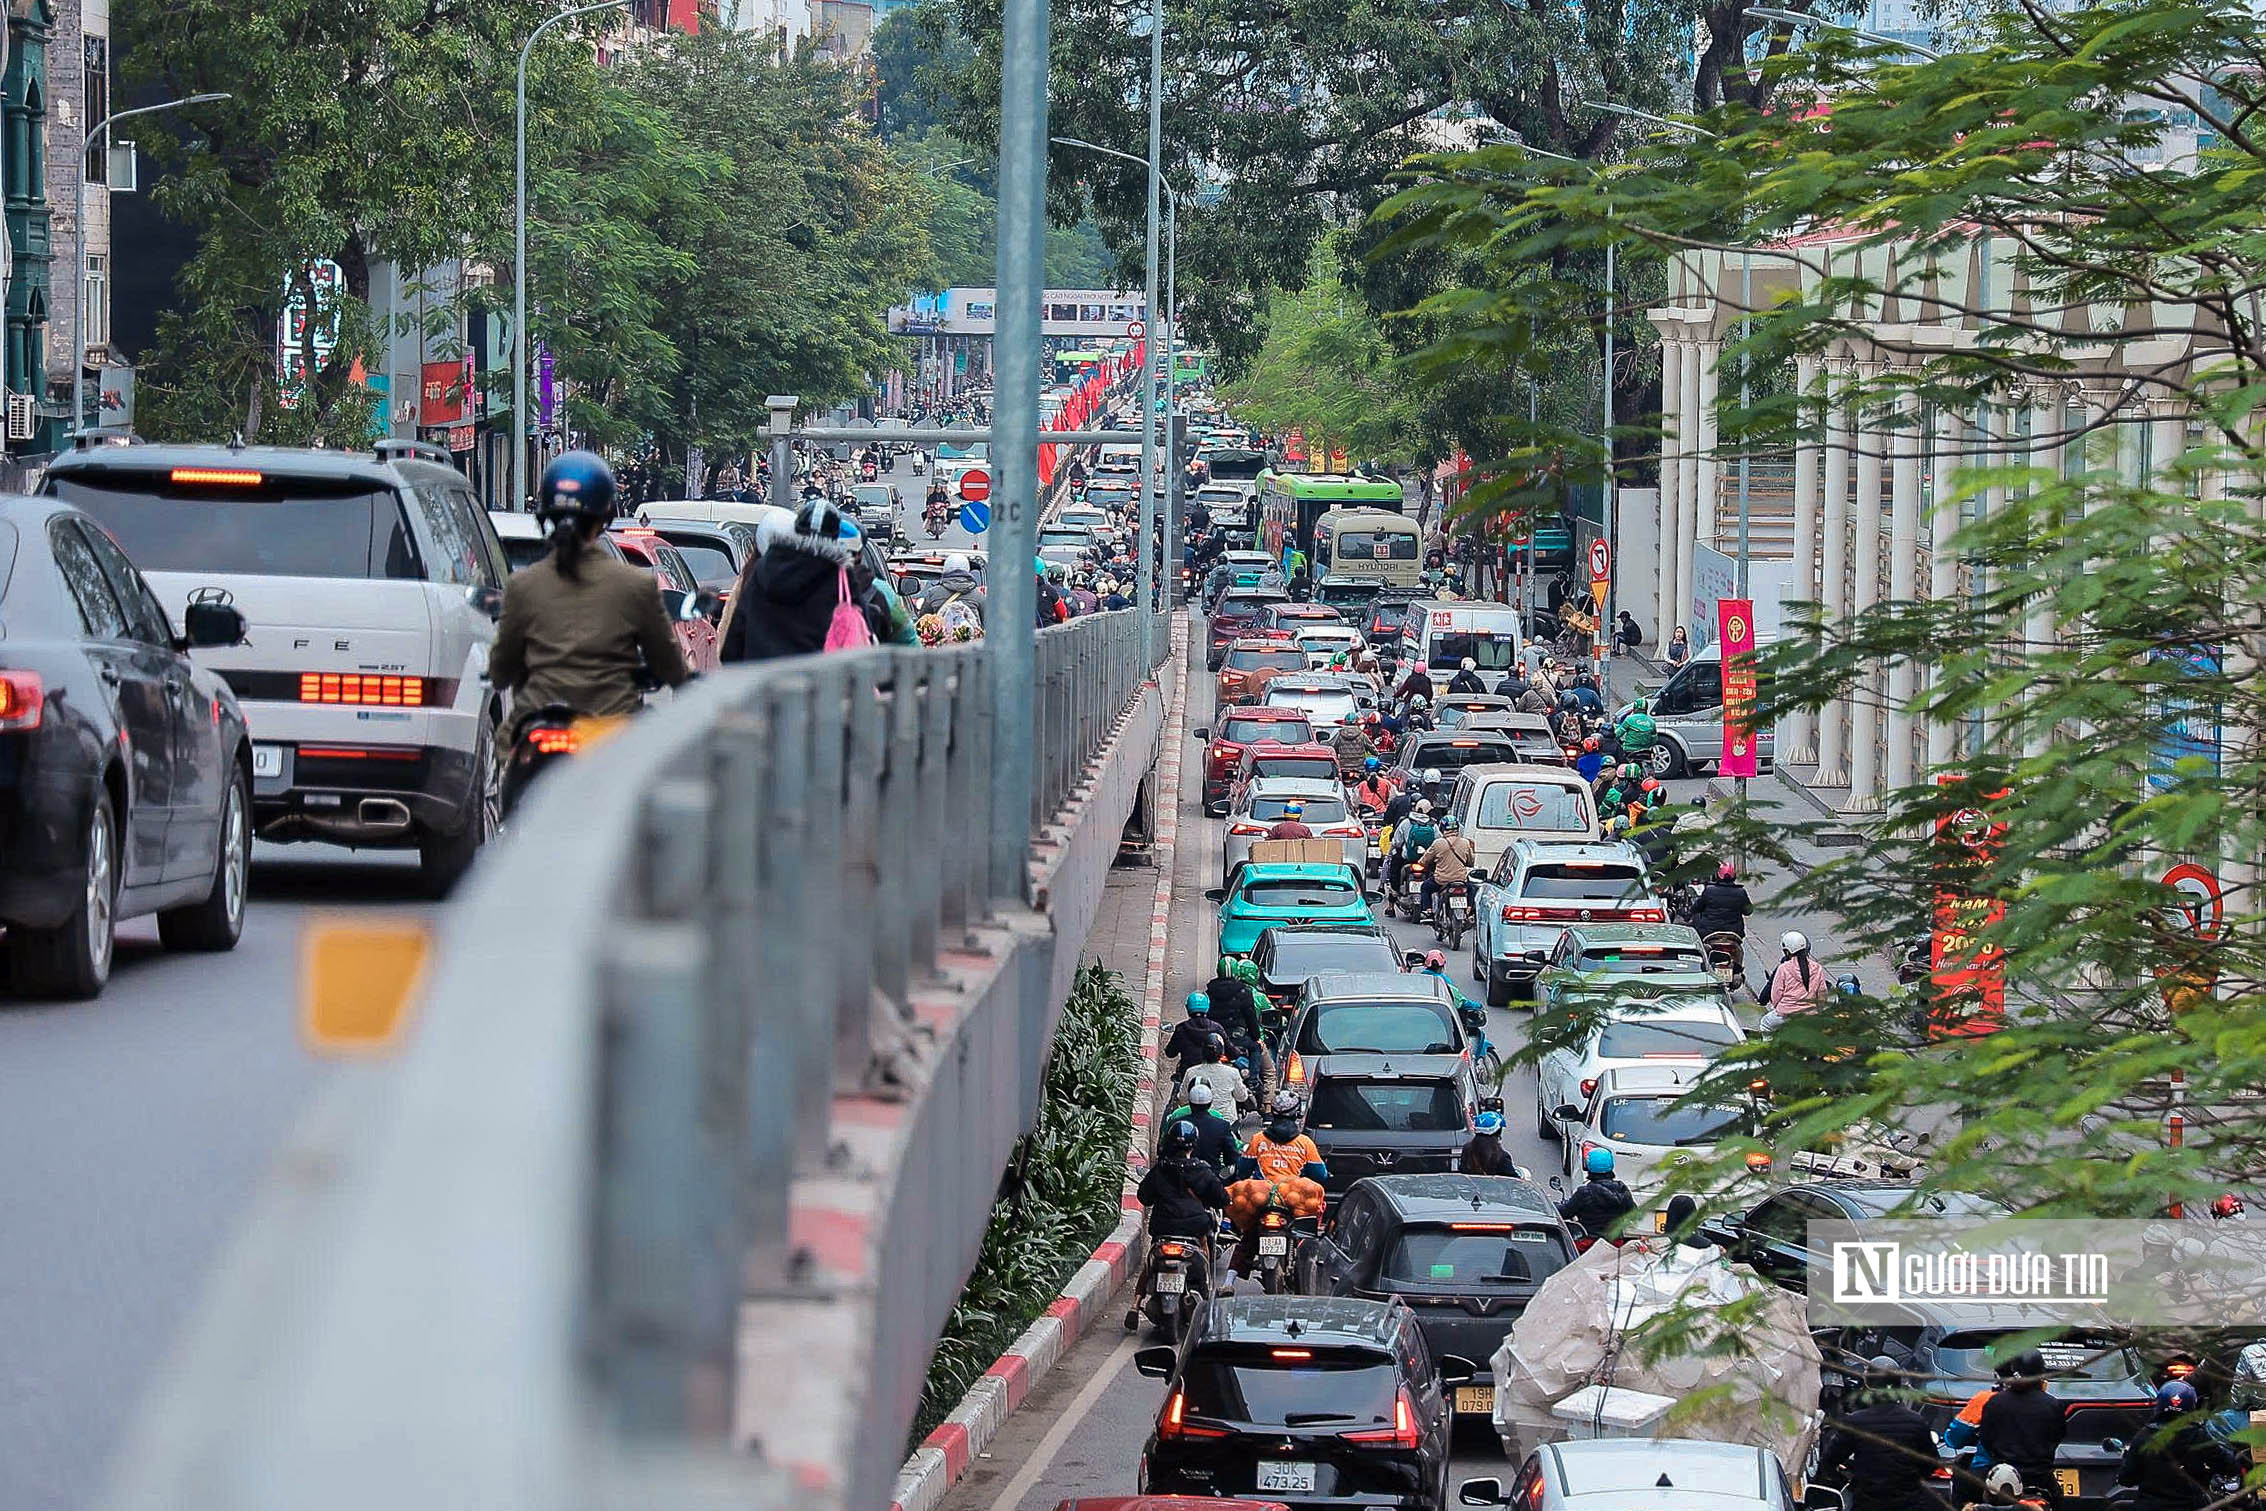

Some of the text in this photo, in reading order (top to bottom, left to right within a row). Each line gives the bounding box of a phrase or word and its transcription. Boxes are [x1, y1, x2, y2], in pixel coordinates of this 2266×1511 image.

[1358, 563, 1399, 572] HYUNDAI
[1273, 1462, 1298, 1475] 30K
[1264, 1475, 1309, 1489] 473.25
